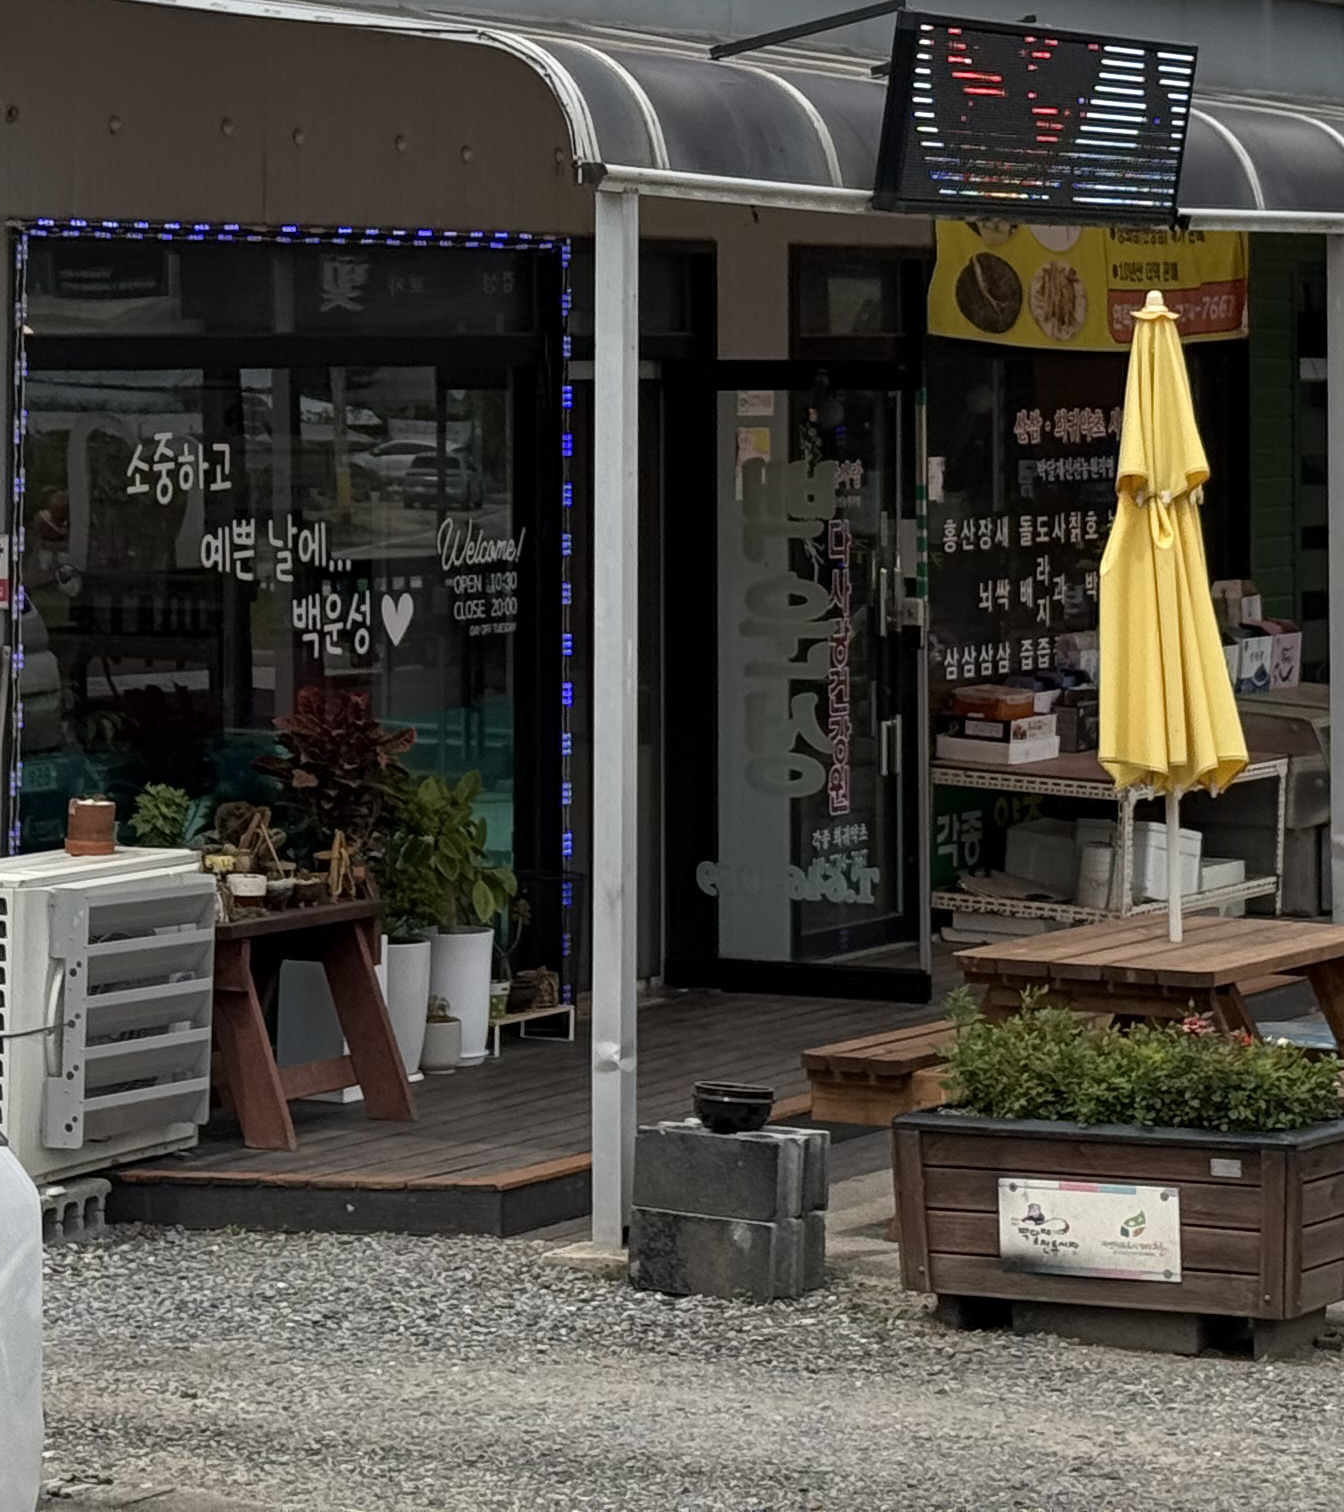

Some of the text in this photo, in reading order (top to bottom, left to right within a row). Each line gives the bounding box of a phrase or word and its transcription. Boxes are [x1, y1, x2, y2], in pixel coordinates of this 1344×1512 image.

[127, 433, 232, 504] 소중하고
[201, 514, 353, 584] 예쁜 날에...
[437, 517, 526, 570] Welcome!
[454, 574, 482, 594] OPEN
[454, 596, 518, 620] CLOSE 20:00
[292, 589, 372, 659] 백운성
[936, 809, 983, 869] 각종
